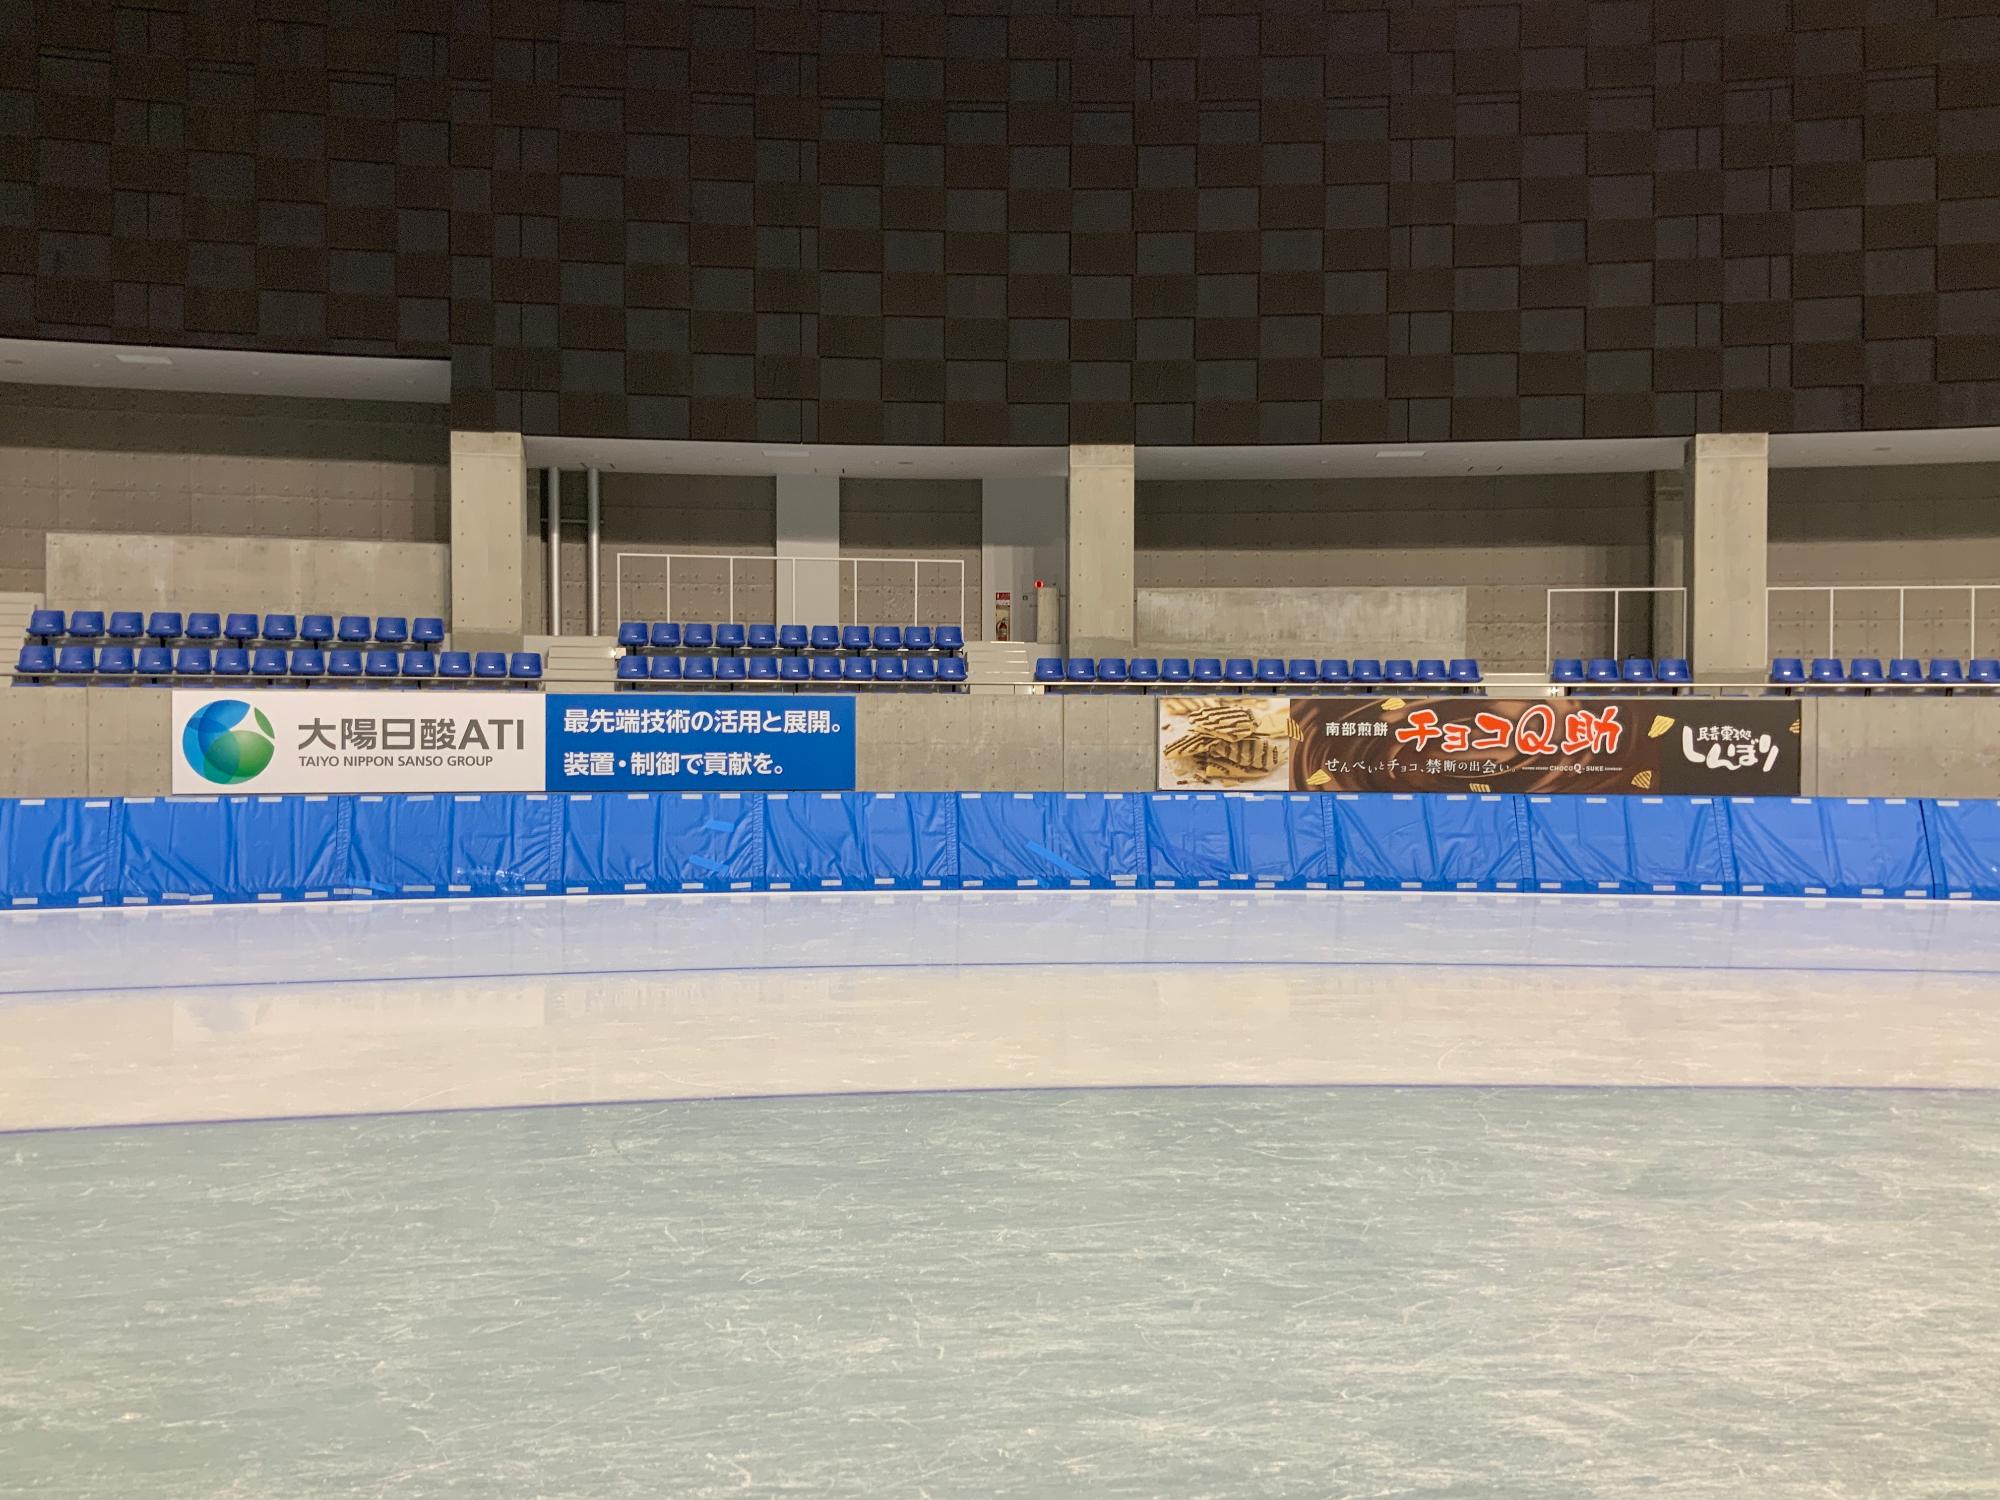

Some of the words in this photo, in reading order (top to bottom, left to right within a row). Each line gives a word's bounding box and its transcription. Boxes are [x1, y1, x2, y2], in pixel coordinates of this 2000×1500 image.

[298, 717, 524, 750] 大陽日酸ATI
[563, 709, 841, 734] 最先端技術の活用と展開。
[1325, 721, 1388, 737] 南部煎餅
[1395, 704, 1623, 755] チョコQ助
[298, 756, 339, 767] TAIYO
[343, 756, 394, 767] NIPPON
[398, 756, 444, 767] SANSO
[447, 756, 494, 767] GROUP
[1682, 725, 1779, 772] しんぼり
[563, 752, 784, 776] 装置・制御で貢献を。
